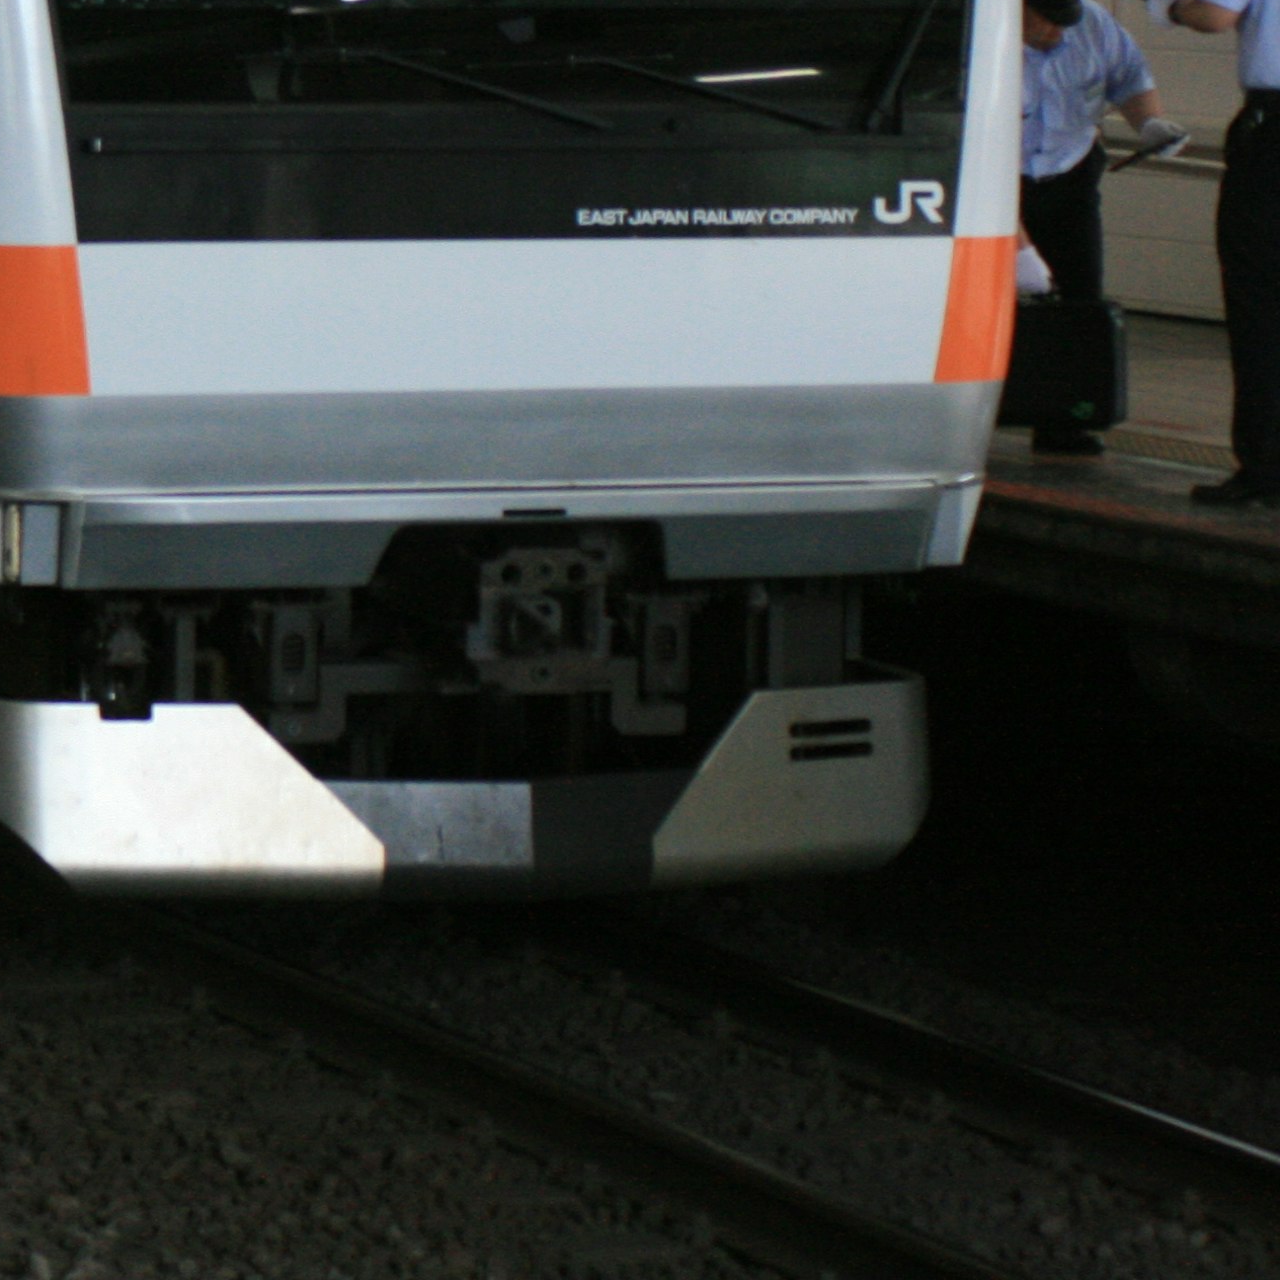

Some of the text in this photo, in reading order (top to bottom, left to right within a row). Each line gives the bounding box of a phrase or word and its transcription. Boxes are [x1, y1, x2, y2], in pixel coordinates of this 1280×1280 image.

[576, 206, 858, 226] EAST JAPAN RAILWAY COMPANY
[872, 179, 945, 223] JR
